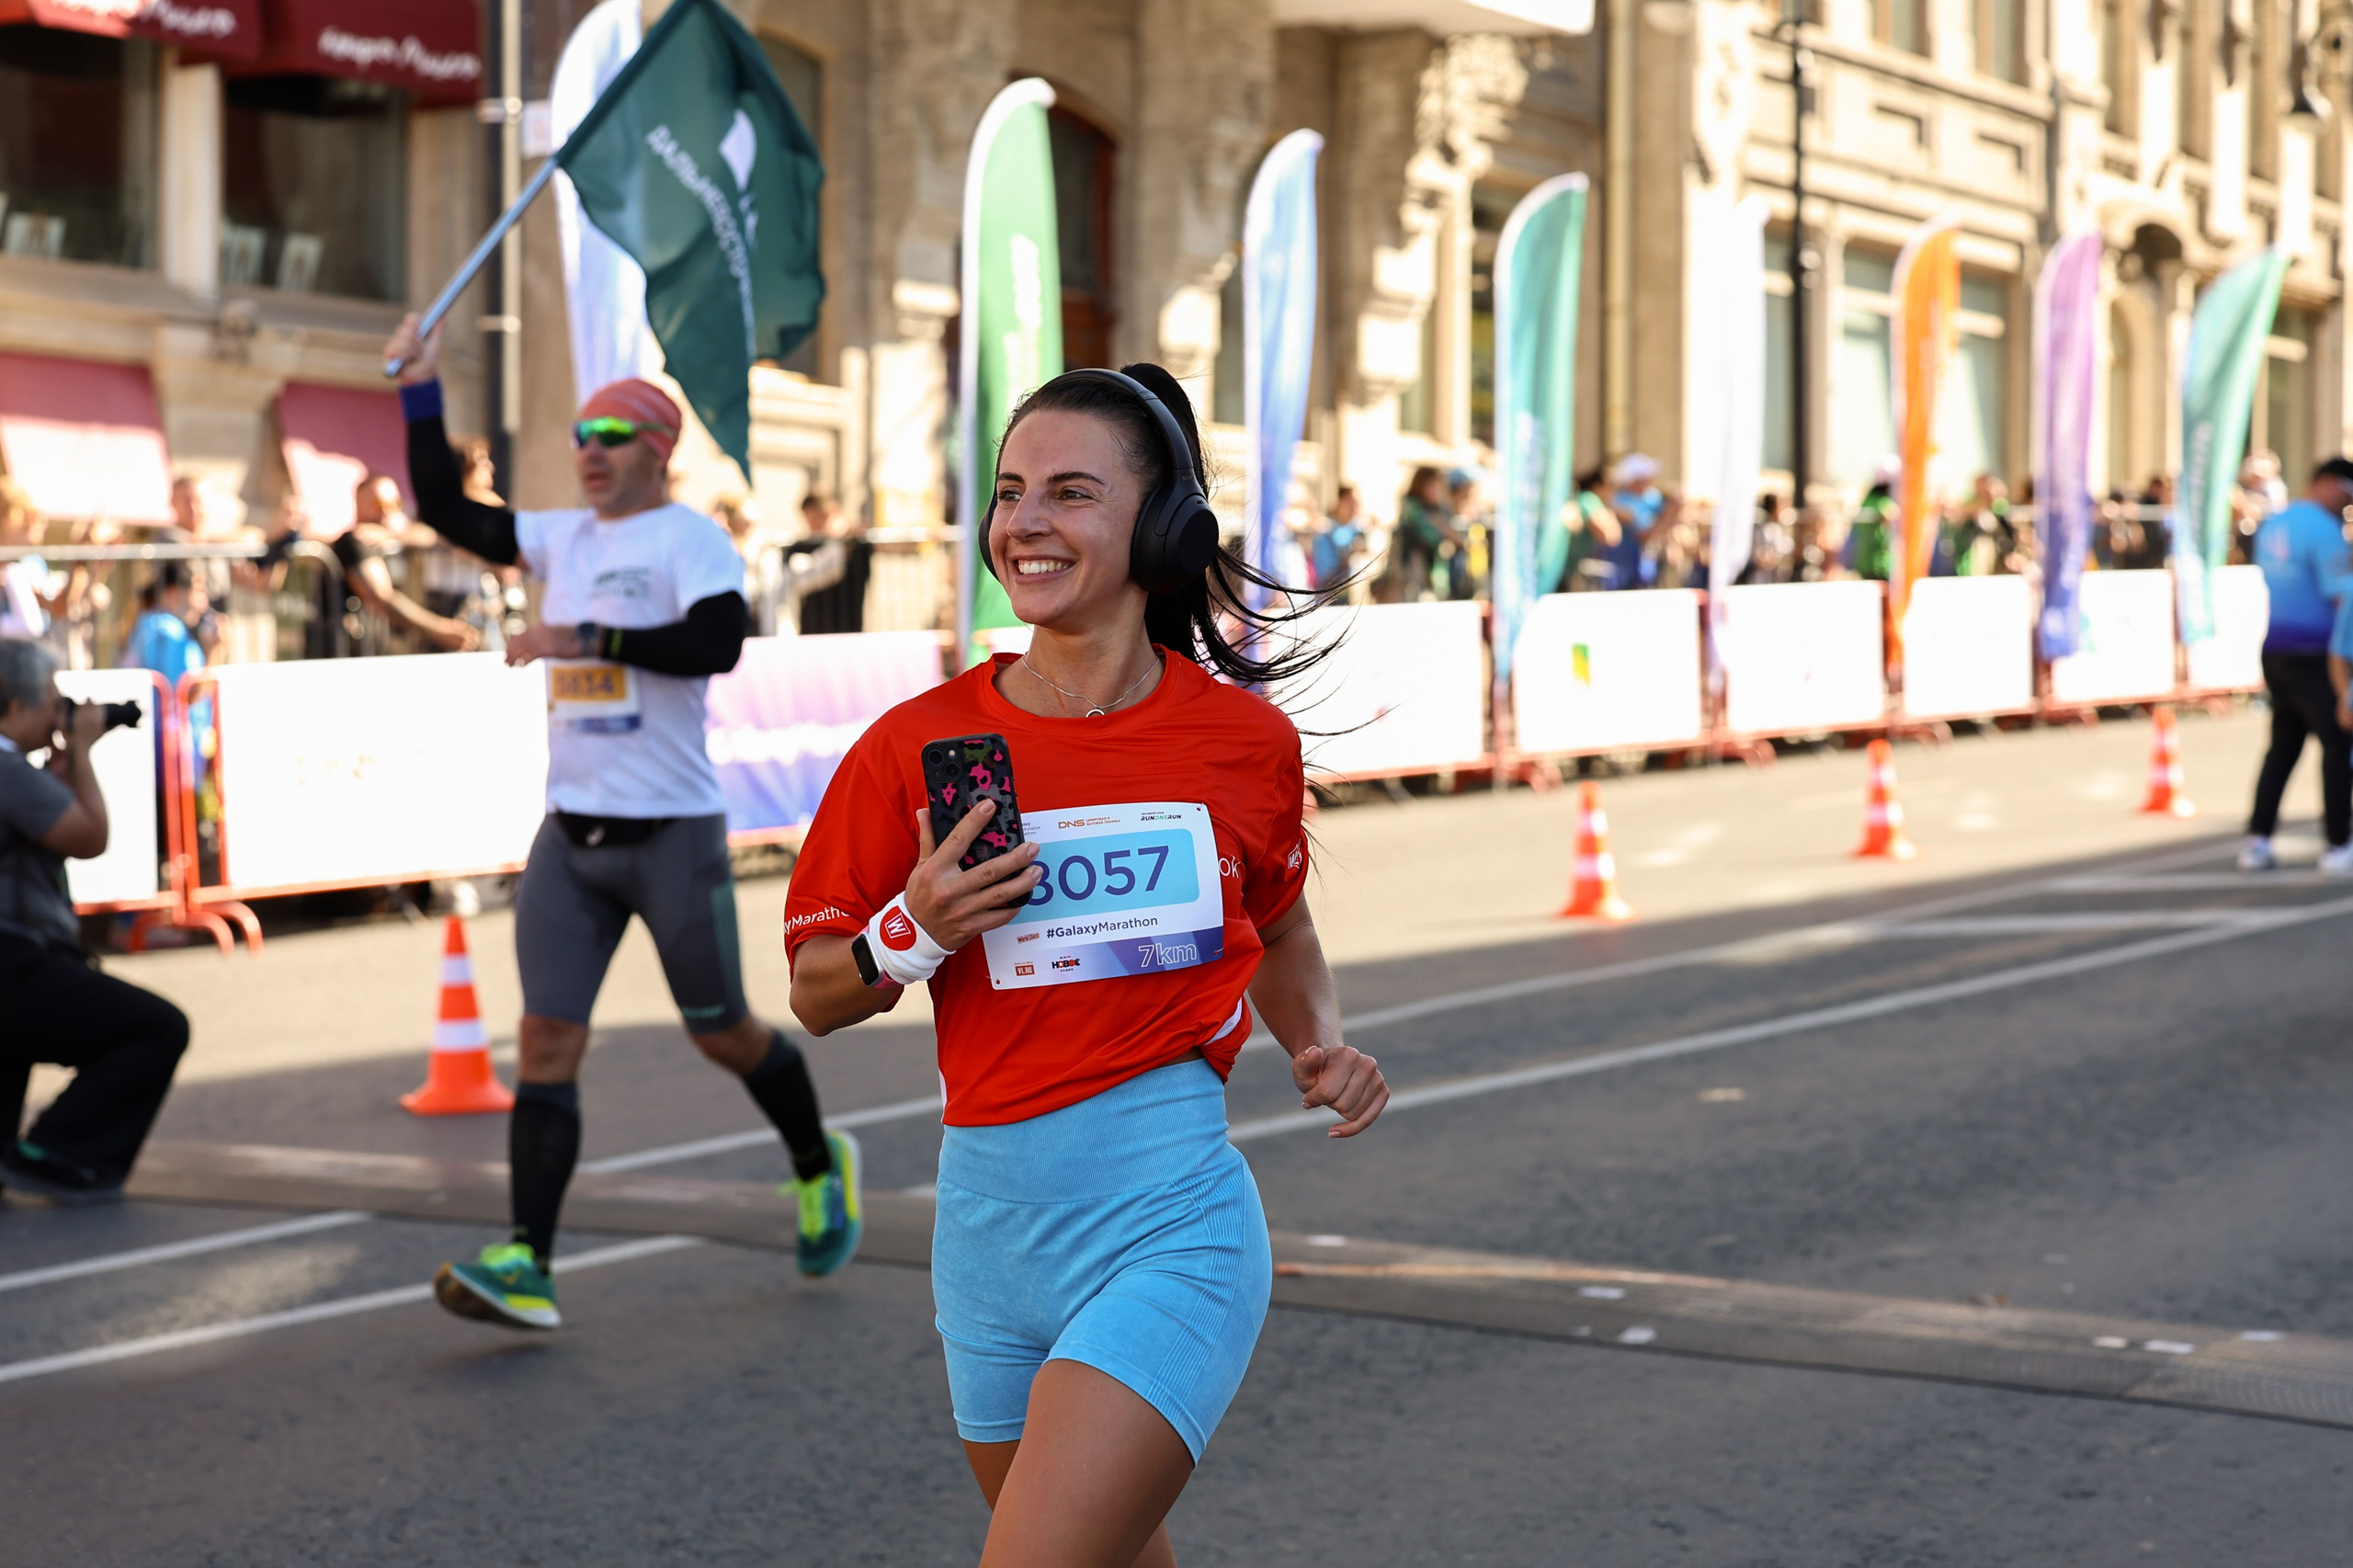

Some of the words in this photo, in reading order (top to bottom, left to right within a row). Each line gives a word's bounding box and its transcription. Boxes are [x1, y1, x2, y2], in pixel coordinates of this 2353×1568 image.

[1058, 819, 1086, 829] DNS
[1046, 915, 1158, 938] #GalaxyMarathon
[1138, 942, 1197, 968] 7km
